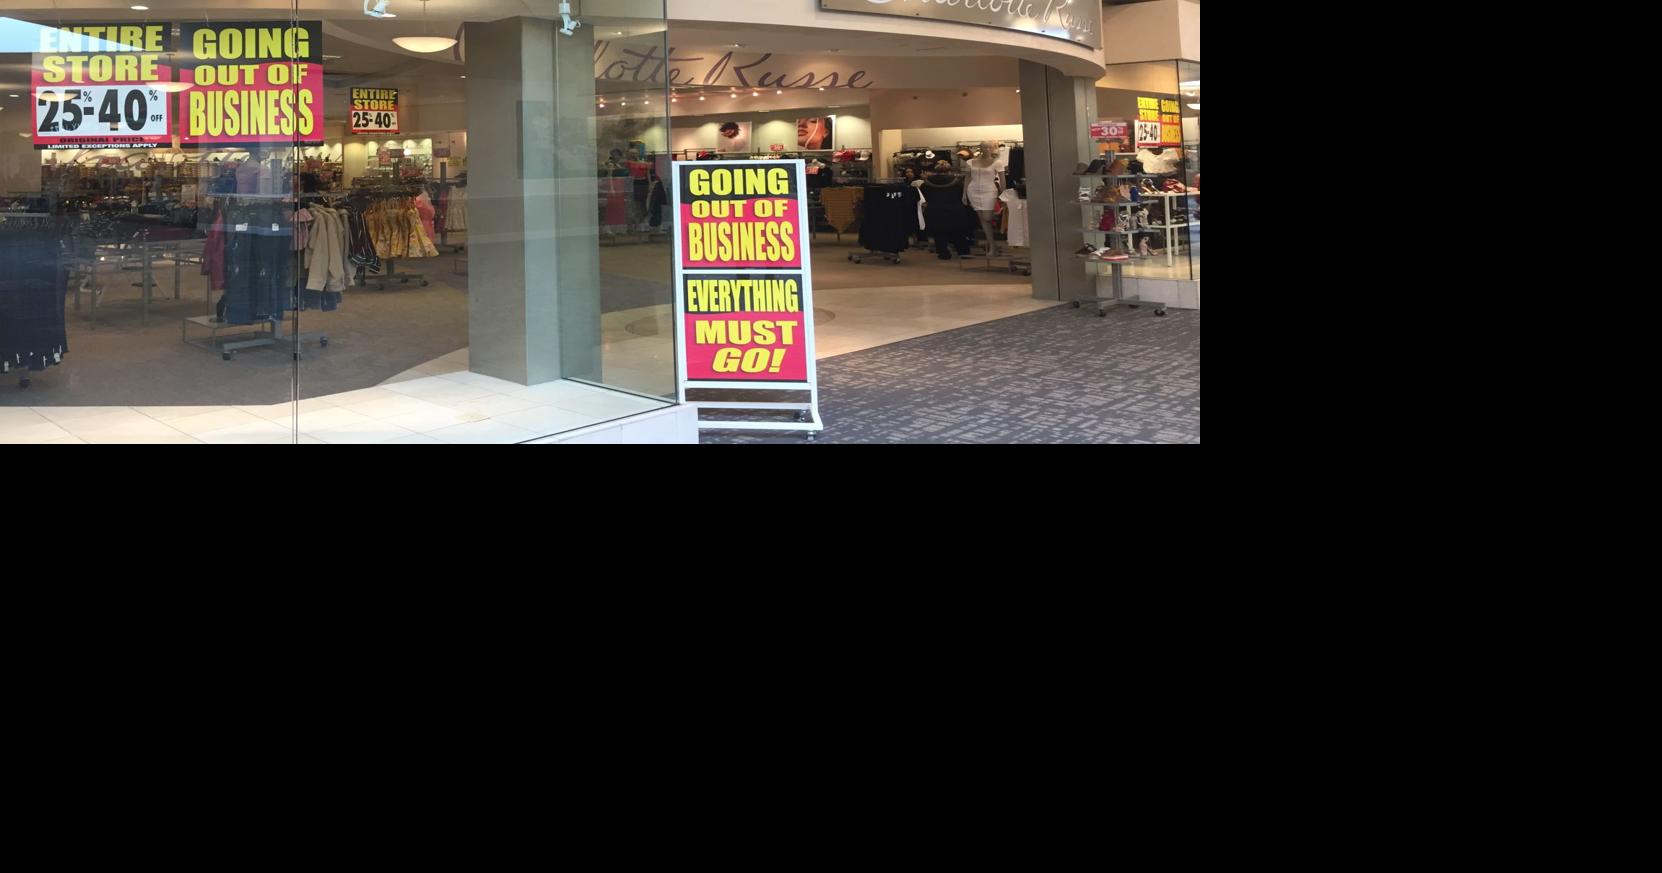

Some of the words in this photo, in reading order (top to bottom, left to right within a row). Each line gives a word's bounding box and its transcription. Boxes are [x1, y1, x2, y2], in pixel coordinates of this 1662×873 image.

[39, 25, 163, 53] ENTIRE
[192, 27, 310, 60] GOING
[42, 54, 159, 83] STORE
[194, 64, 260, 86] OUT
[267, 63, 308, 85] OF
[702, 50, 875, 89] Russe
[352, 88, 397, 100] ENTIRE
[353, 99, 395, 111] STORE
[150, 114, 163, 122] OFF
[189, 88, 314, 137] BUSINESS
[688, 167, 790, 197] GOING
[691, 199, 748, 218] OUT
[753, 198, 788, 218] OF
[688, 220, 796, 262] BUSINESS
[686, 278, 799, 313] EVERYTHING
[695, 319, 798, 345] MUST
[711, 347, 787, 373] GO!
